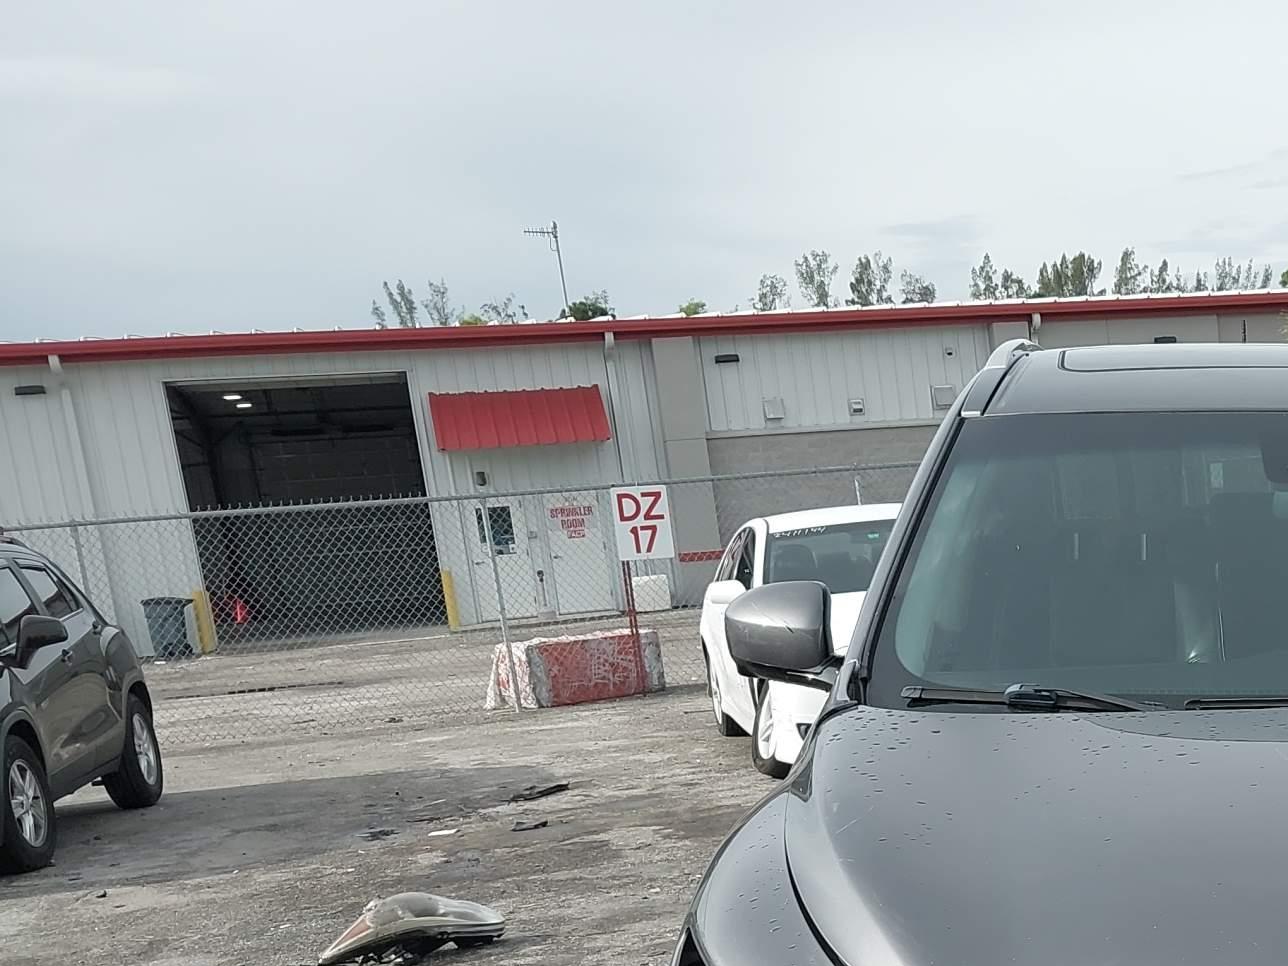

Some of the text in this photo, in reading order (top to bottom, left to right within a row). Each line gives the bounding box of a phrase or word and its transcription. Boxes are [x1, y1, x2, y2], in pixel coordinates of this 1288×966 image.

[616, 491, 665, 522] DZ
[561, 517, 586, 530] ROOM
[629, 524, 658, 554] 17
